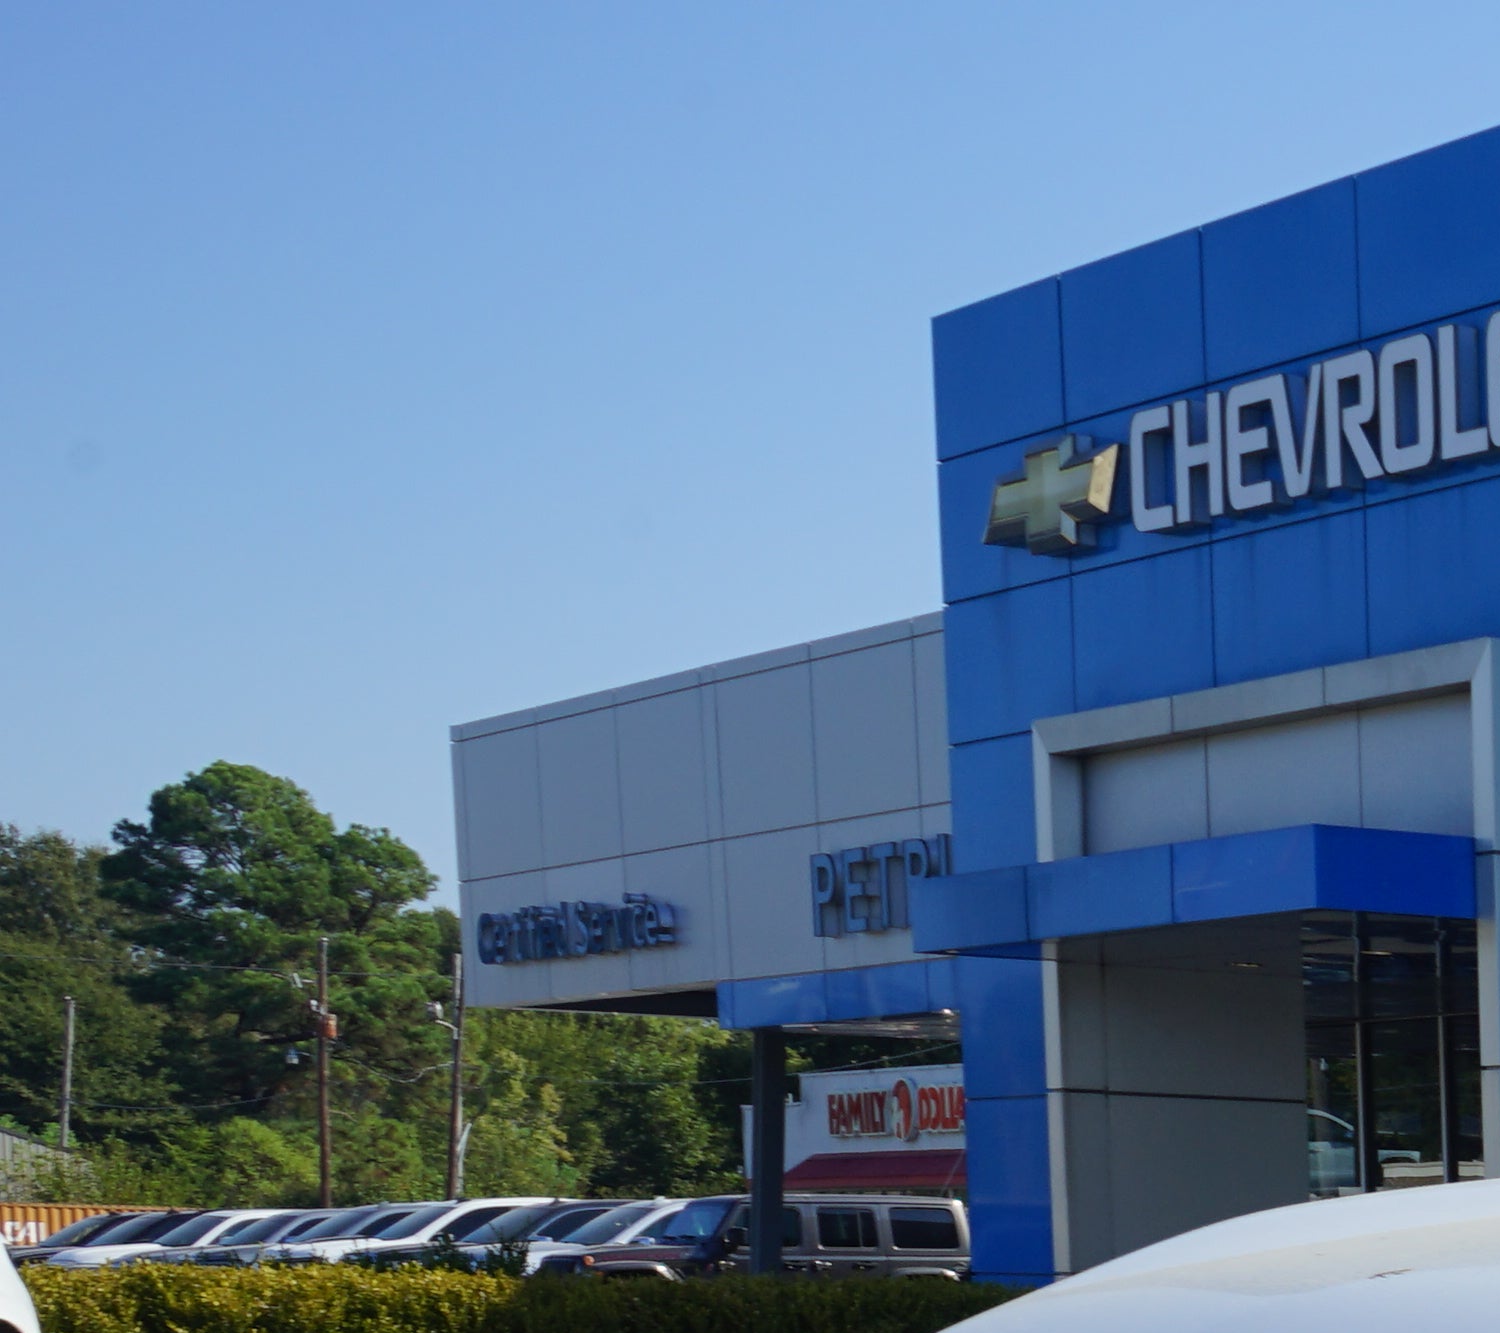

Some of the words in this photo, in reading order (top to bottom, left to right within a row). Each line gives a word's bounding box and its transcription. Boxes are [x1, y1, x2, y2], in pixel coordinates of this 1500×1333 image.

[477, 899, 572, 965] Certified
[573, 892, 675, 957] Service
[827, 1090, 888, 1135] FAMILY
